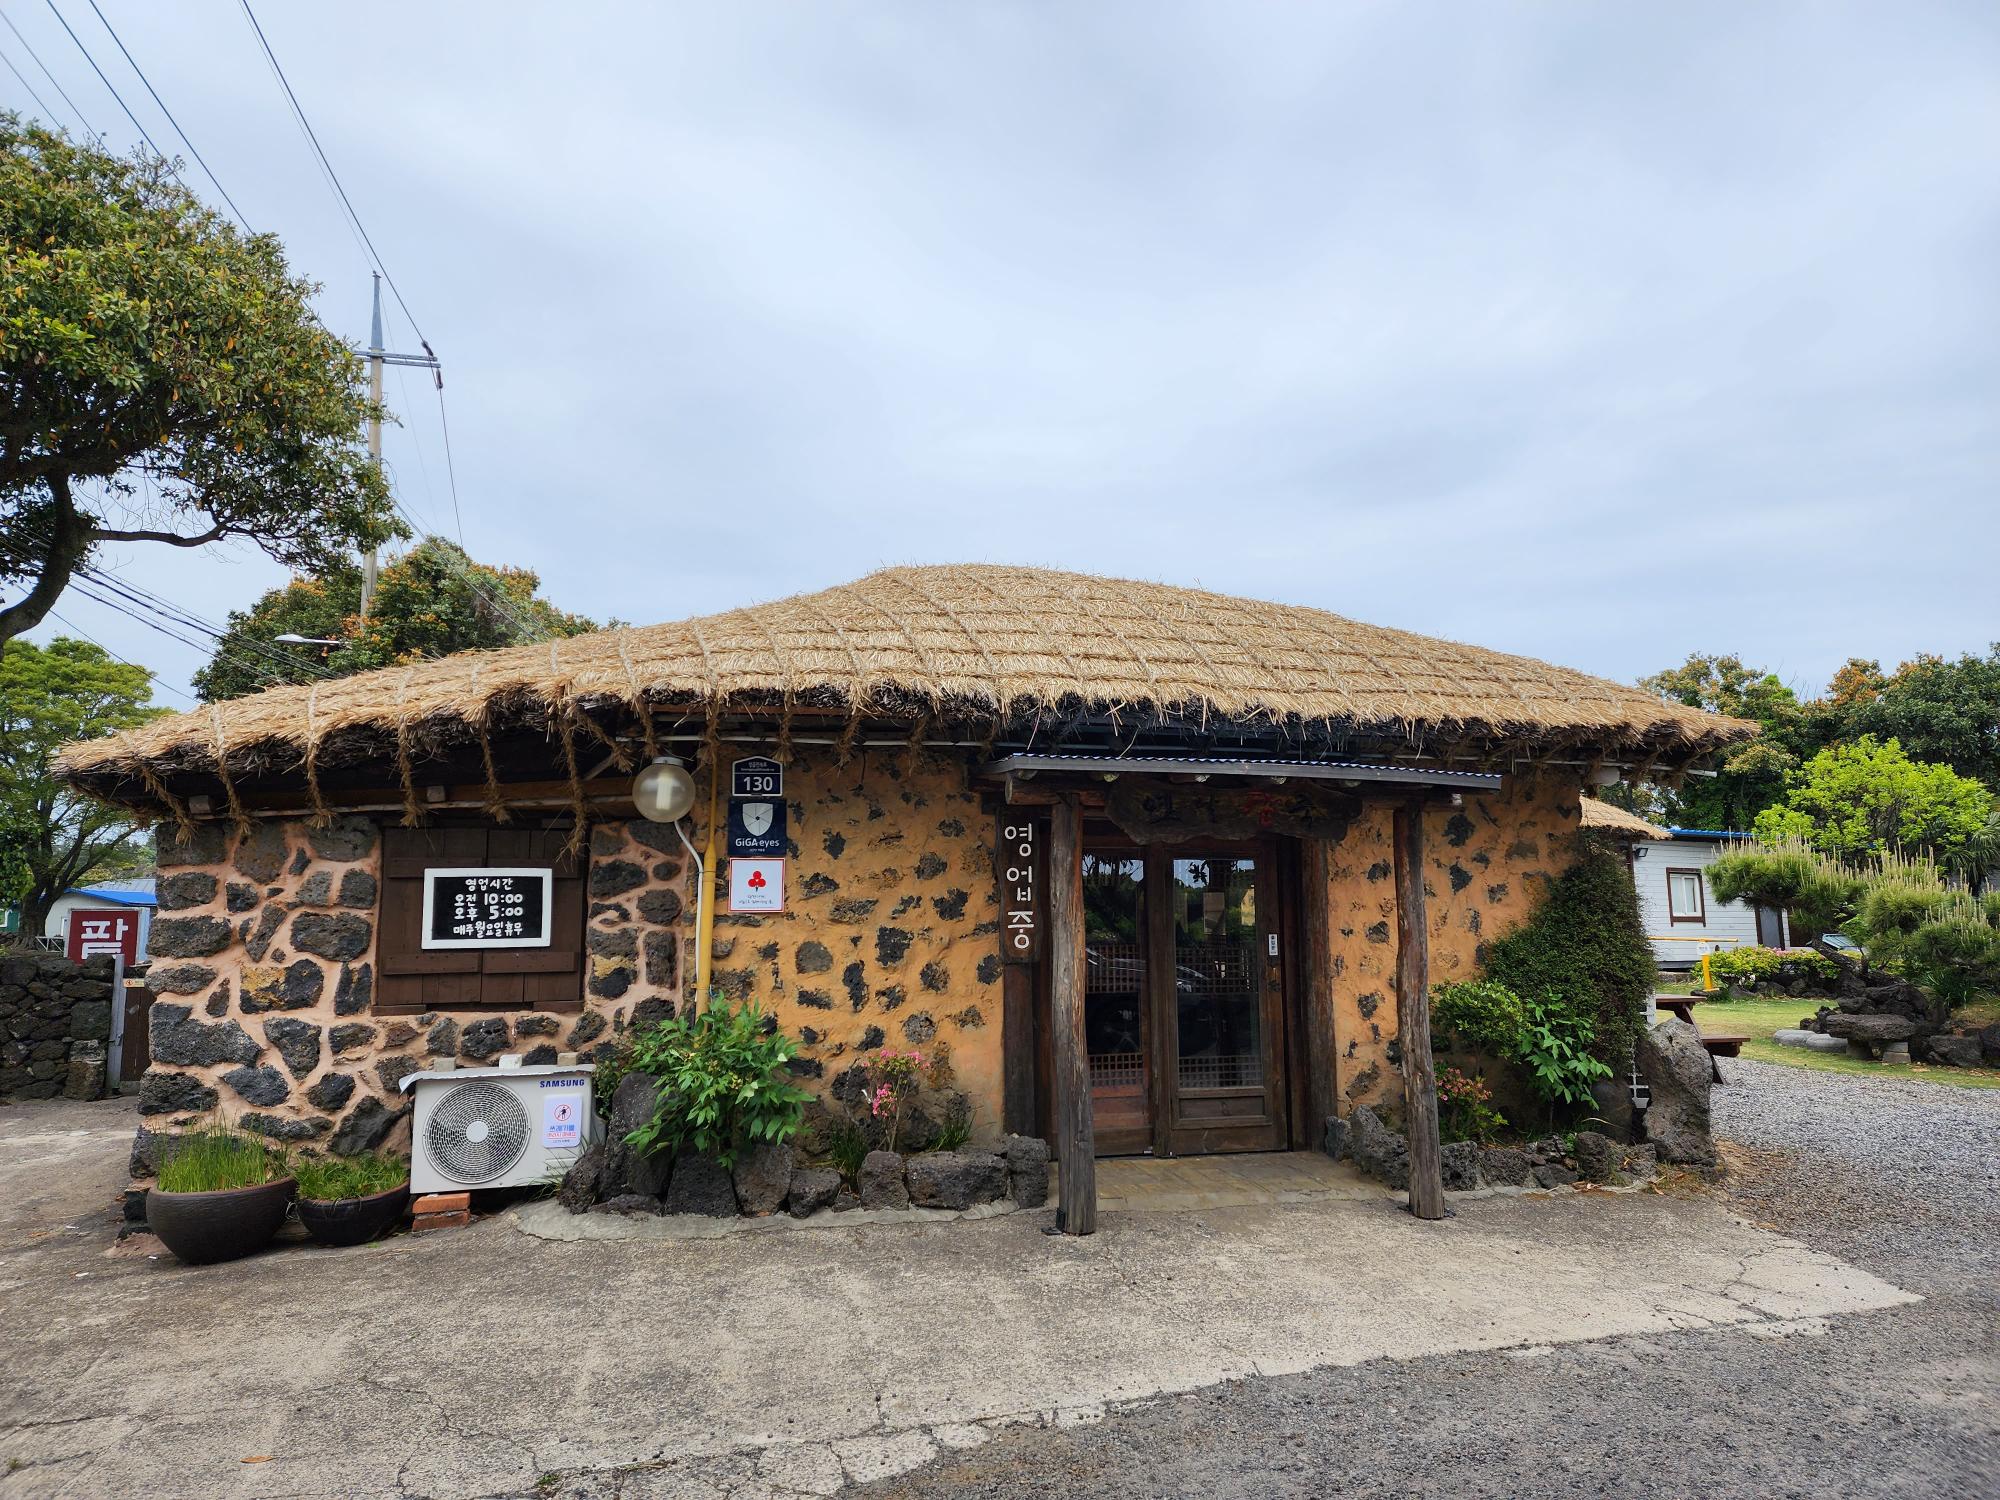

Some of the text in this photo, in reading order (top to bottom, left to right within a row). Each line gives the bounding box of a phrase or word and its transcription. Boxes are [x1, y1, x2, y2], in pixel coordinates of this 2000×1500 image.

[743, 776, 773, 792] 130
[465, 878, 514, 891] 영업시간
[1004, 822, 1035, 949] 영업중
[454, 892, 523, 907] 오전 10:00
[454, 905, 524, 921] 오후 5:00
[540, 1079, 585, 1088] SAMSUNG
